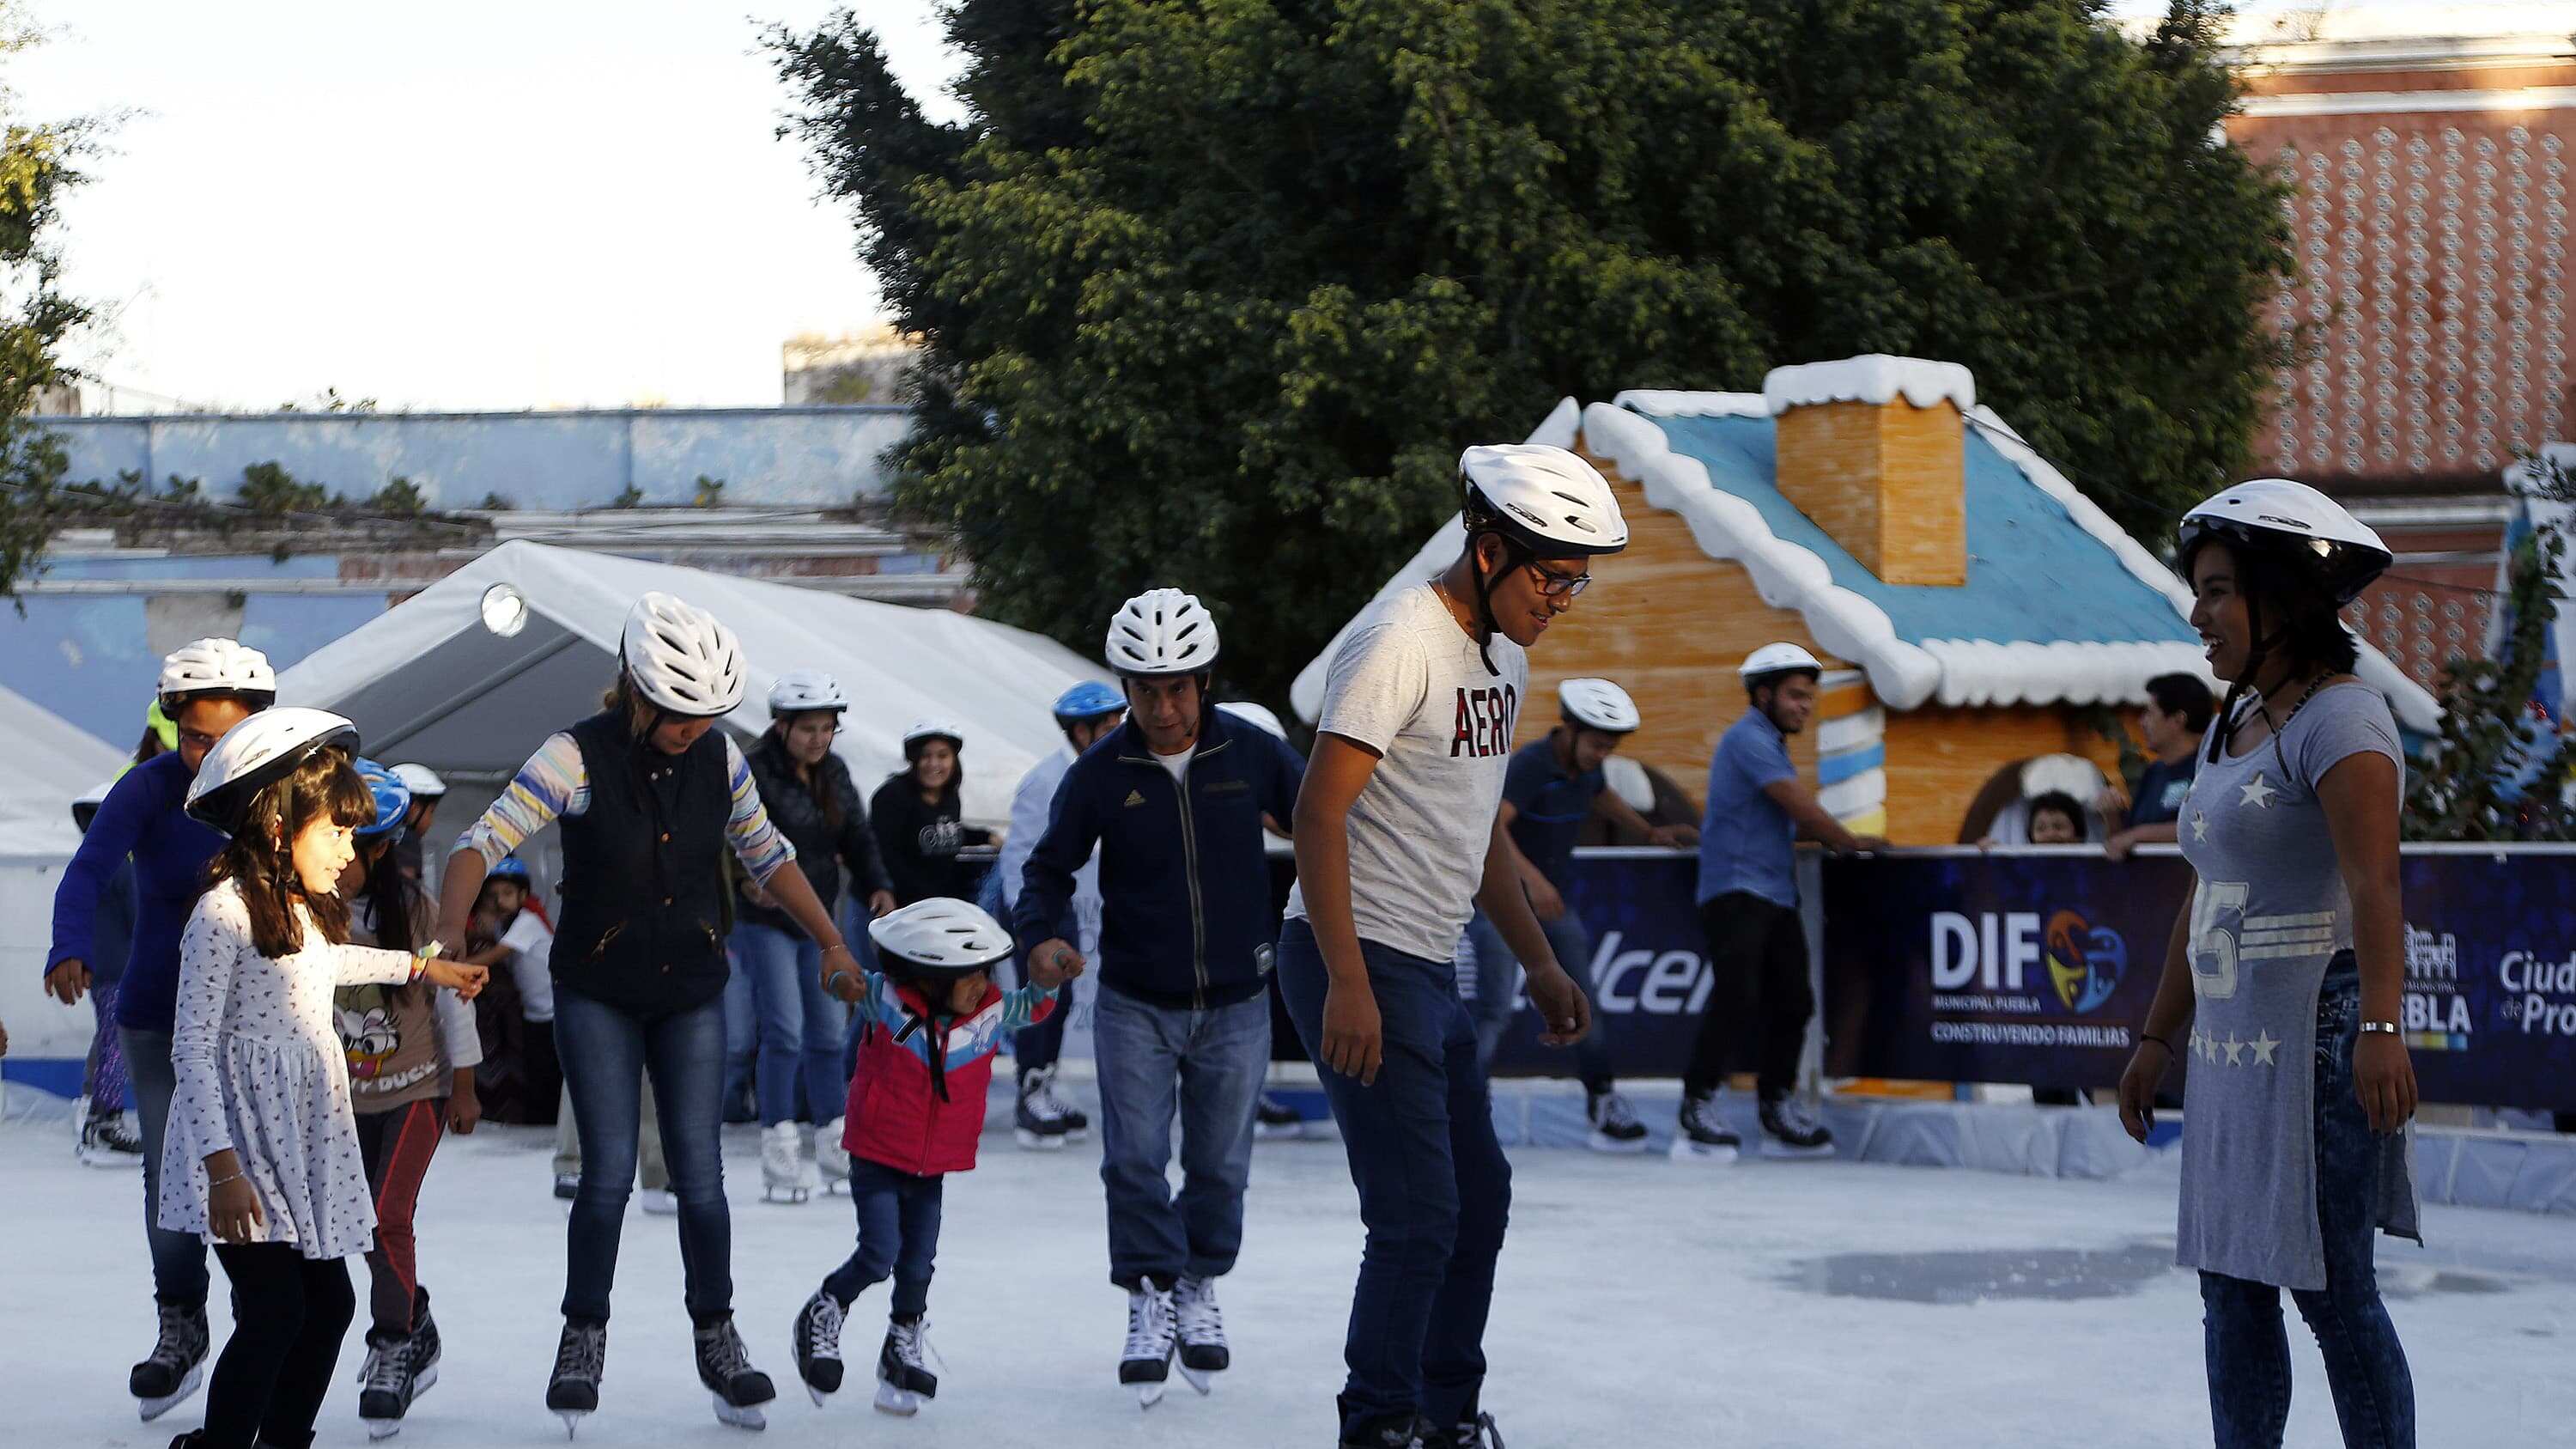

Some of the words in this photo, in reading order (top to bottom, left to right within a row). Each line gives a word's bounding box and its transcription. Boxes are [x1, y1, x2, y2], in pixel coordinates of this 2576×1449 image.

[1930, 911, 2041, 989] DIF
[1931, 995, 1991, 1011] MUNICIPAL
[1994, 995, 2041, 1013] PUEBLA
[1930, 1021, 2056, 1045] CONSTRUYENDO
[2057, 1024, 2129, 1047] FAMILIAS
